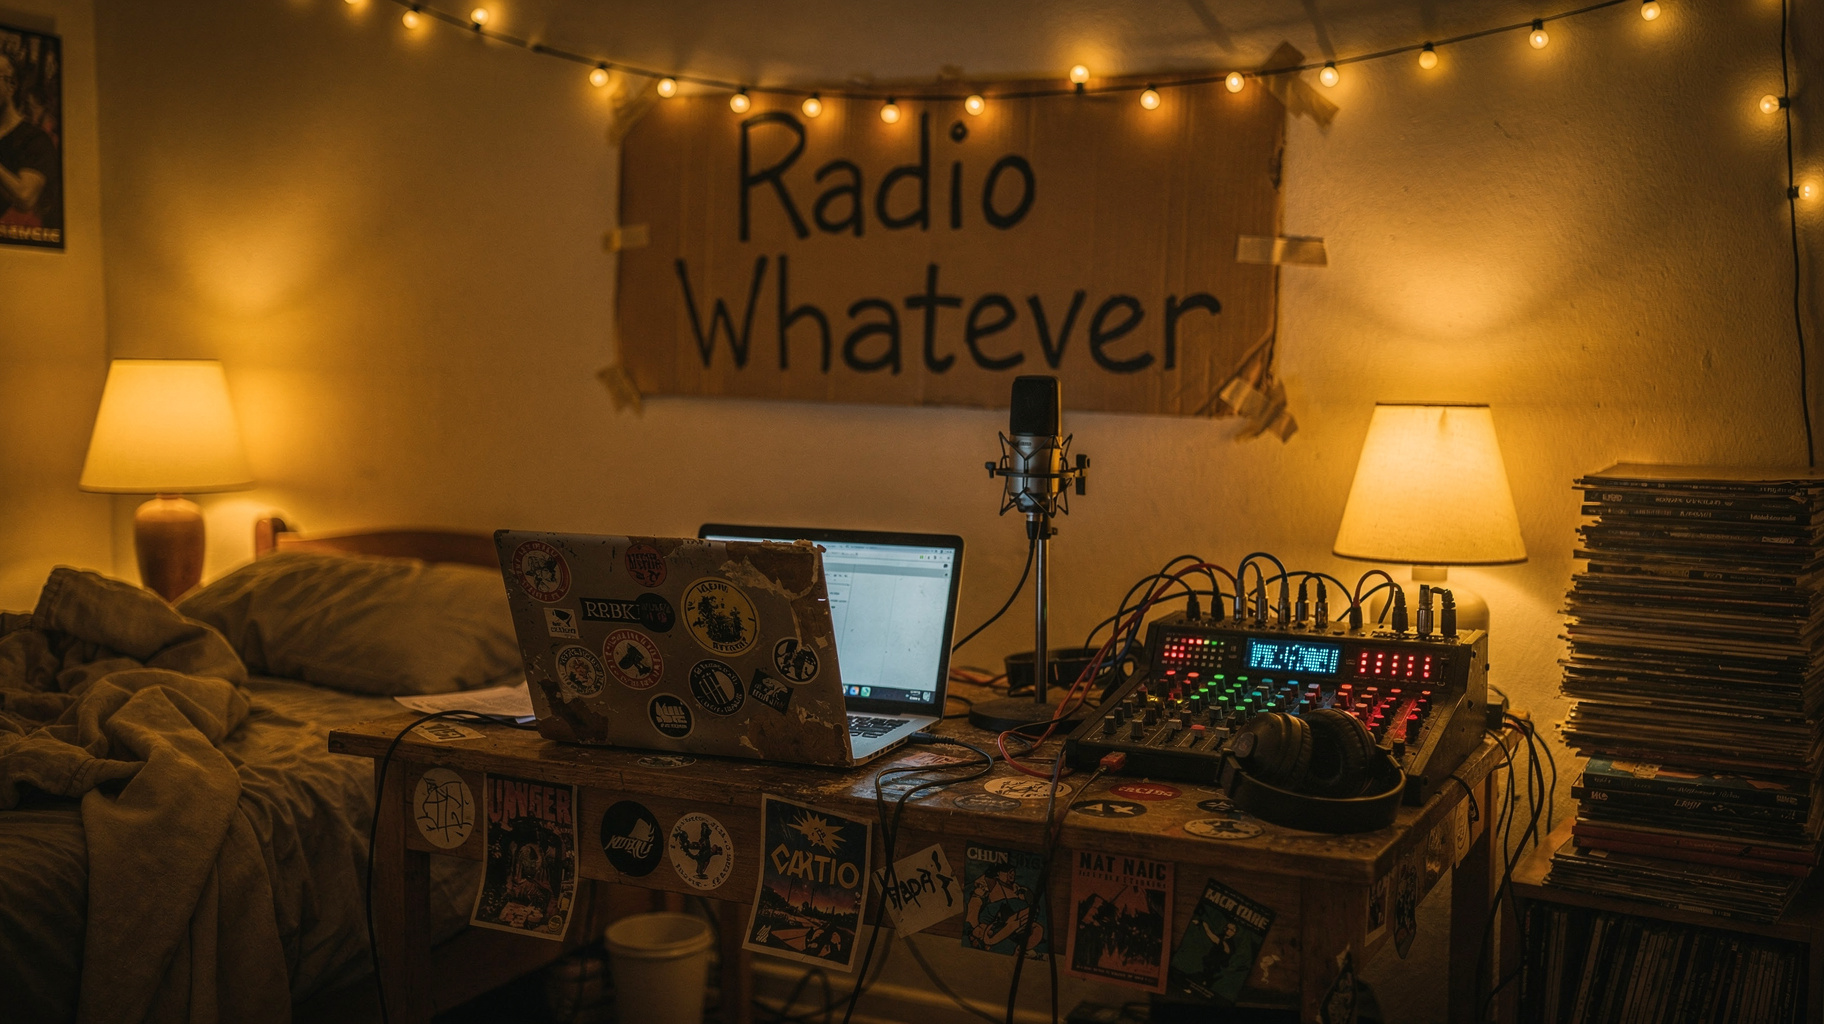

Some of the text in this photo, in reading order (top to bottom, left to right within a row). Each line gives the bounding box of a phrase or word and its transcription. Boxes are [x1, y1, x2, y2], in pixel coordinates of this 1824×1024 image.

[739, 110, 1036, 242] Radio
[676, 254, 1222, 375] Whatever
[1080, 852, 1115, 873] NAT
[1123, 858, 1167, 881] NAIC
